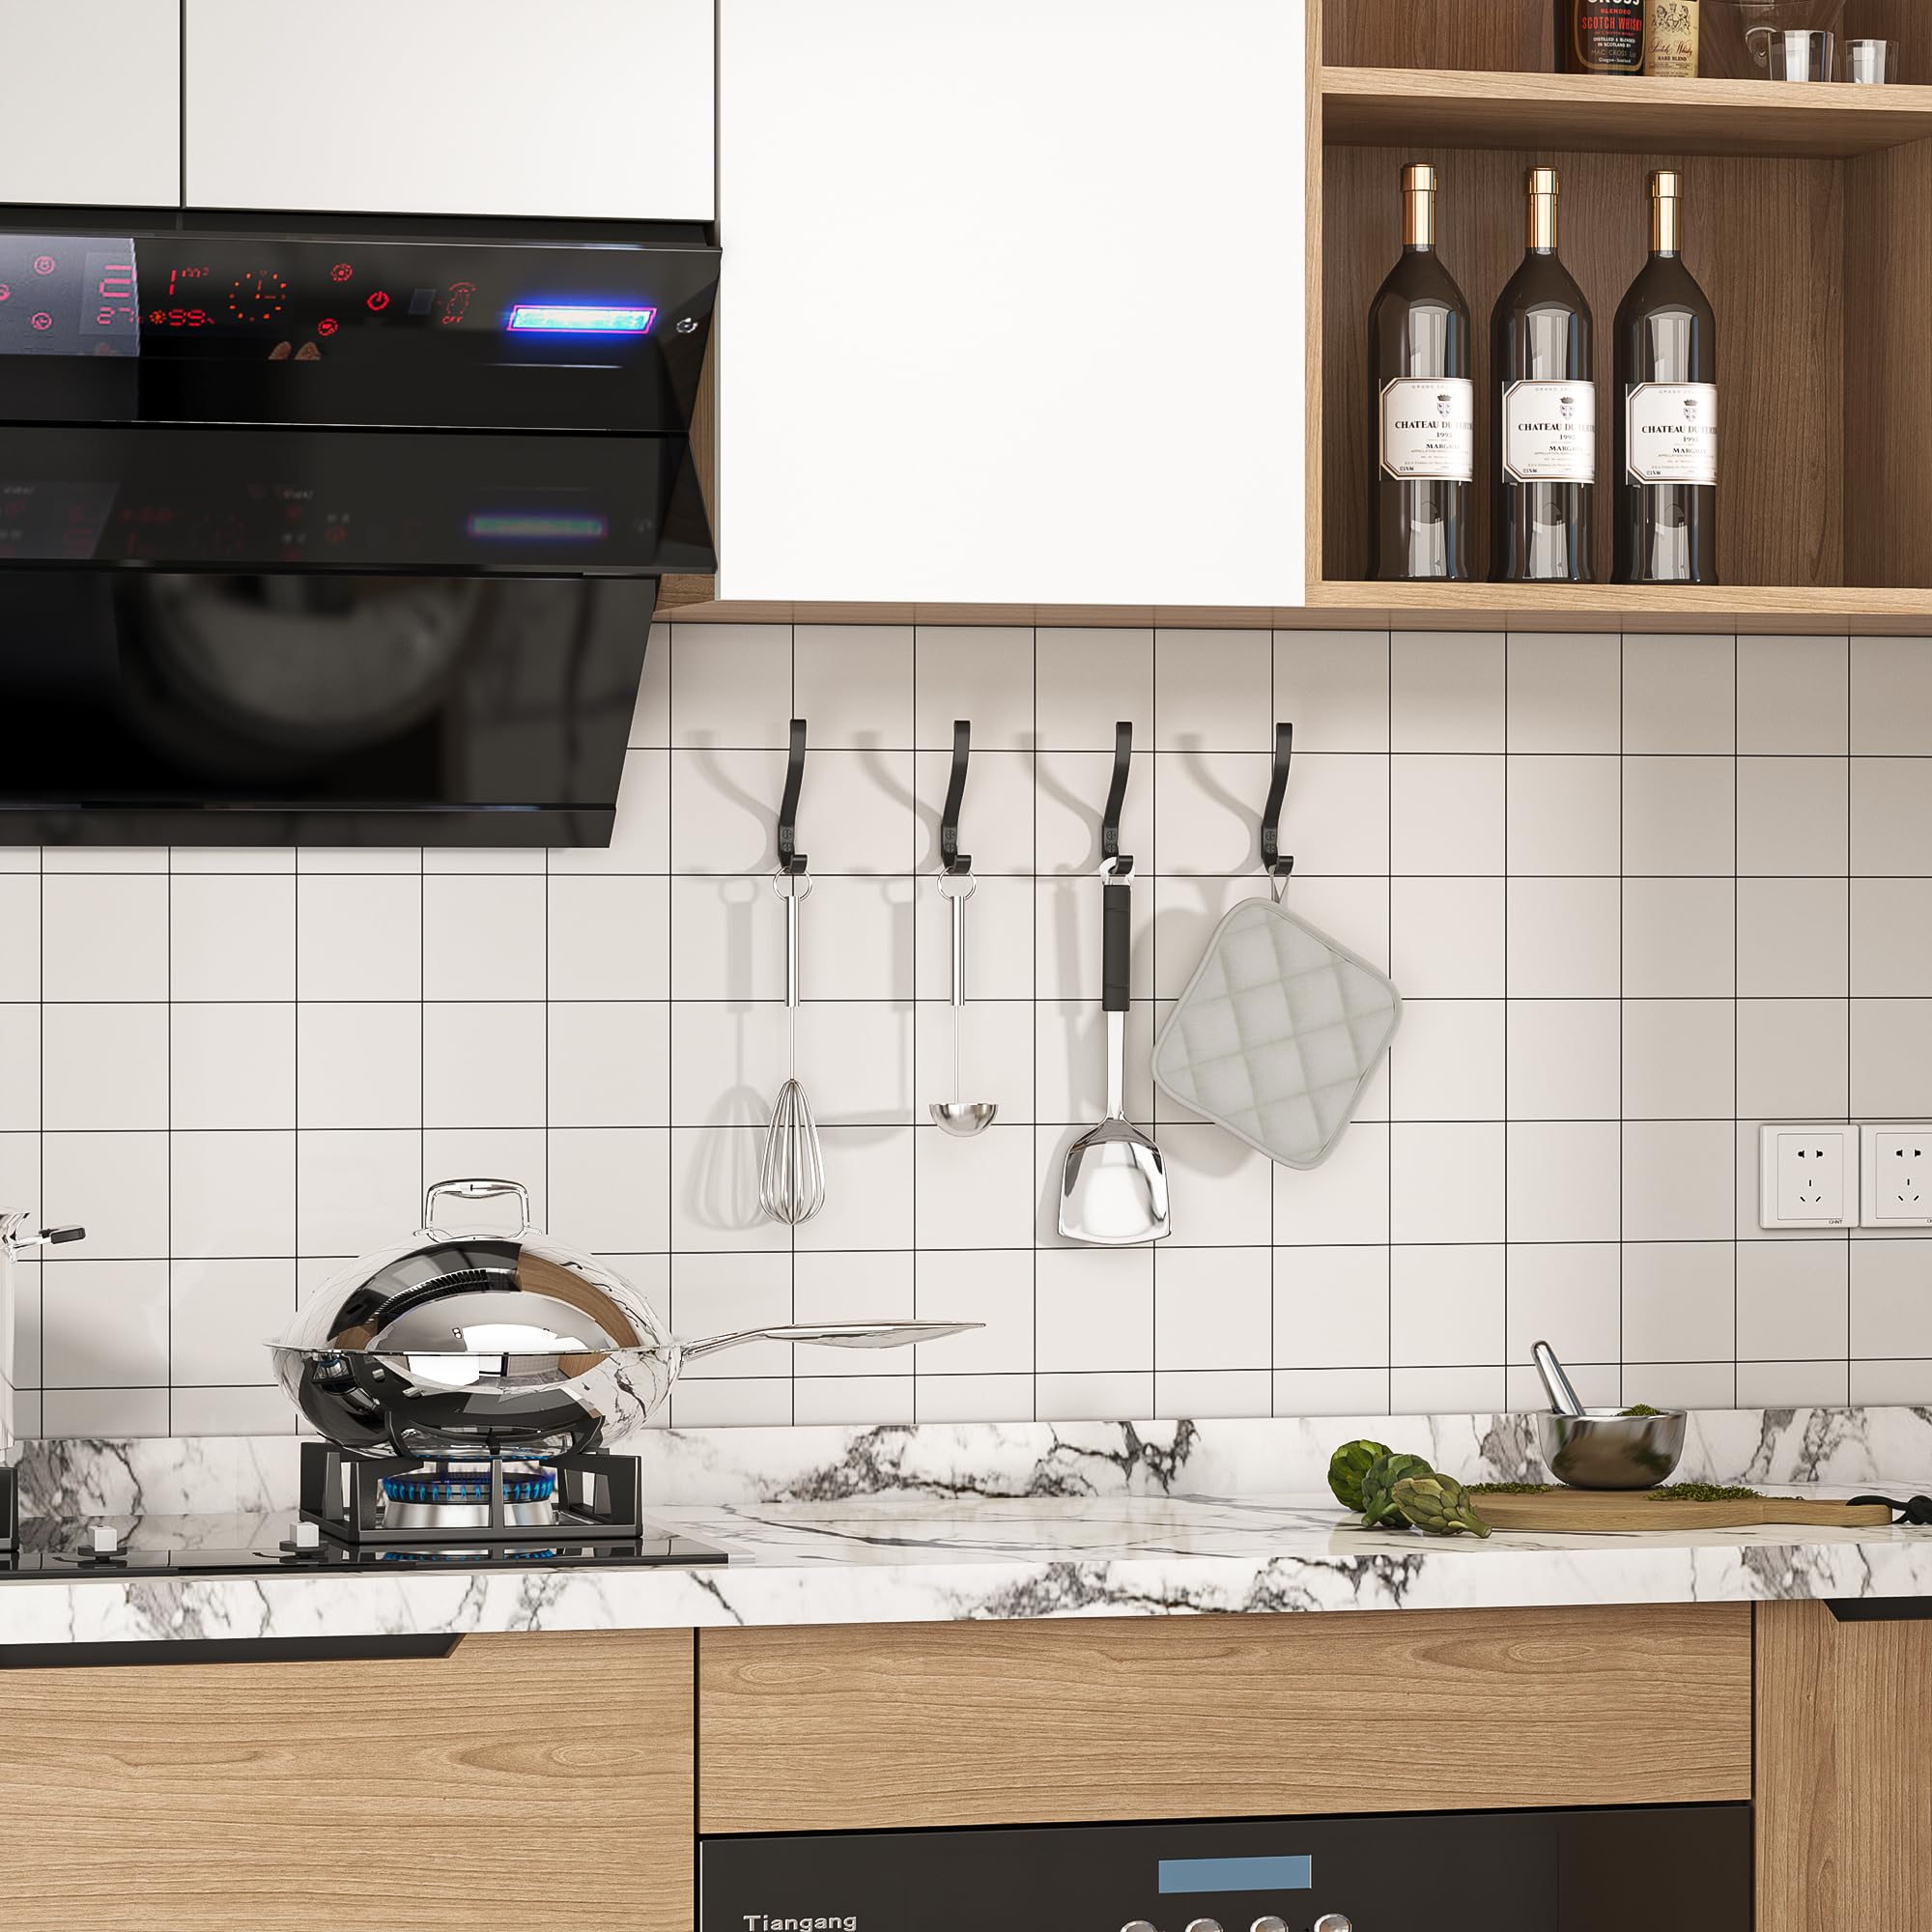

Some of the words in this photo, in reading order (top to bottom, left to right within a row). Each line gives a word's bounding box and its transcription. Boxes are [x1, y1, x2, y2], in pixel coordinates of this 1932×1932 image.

[1581, 16, 1615, 30] SCOTCH
[1395, 420, 1439, 430] CHATEAU
[1518, 423, 1562, 432] CHATEAU
[1642, 425, 1687, 434] CHATEAU
[743, 1914, 857, 1932] Tiangang
